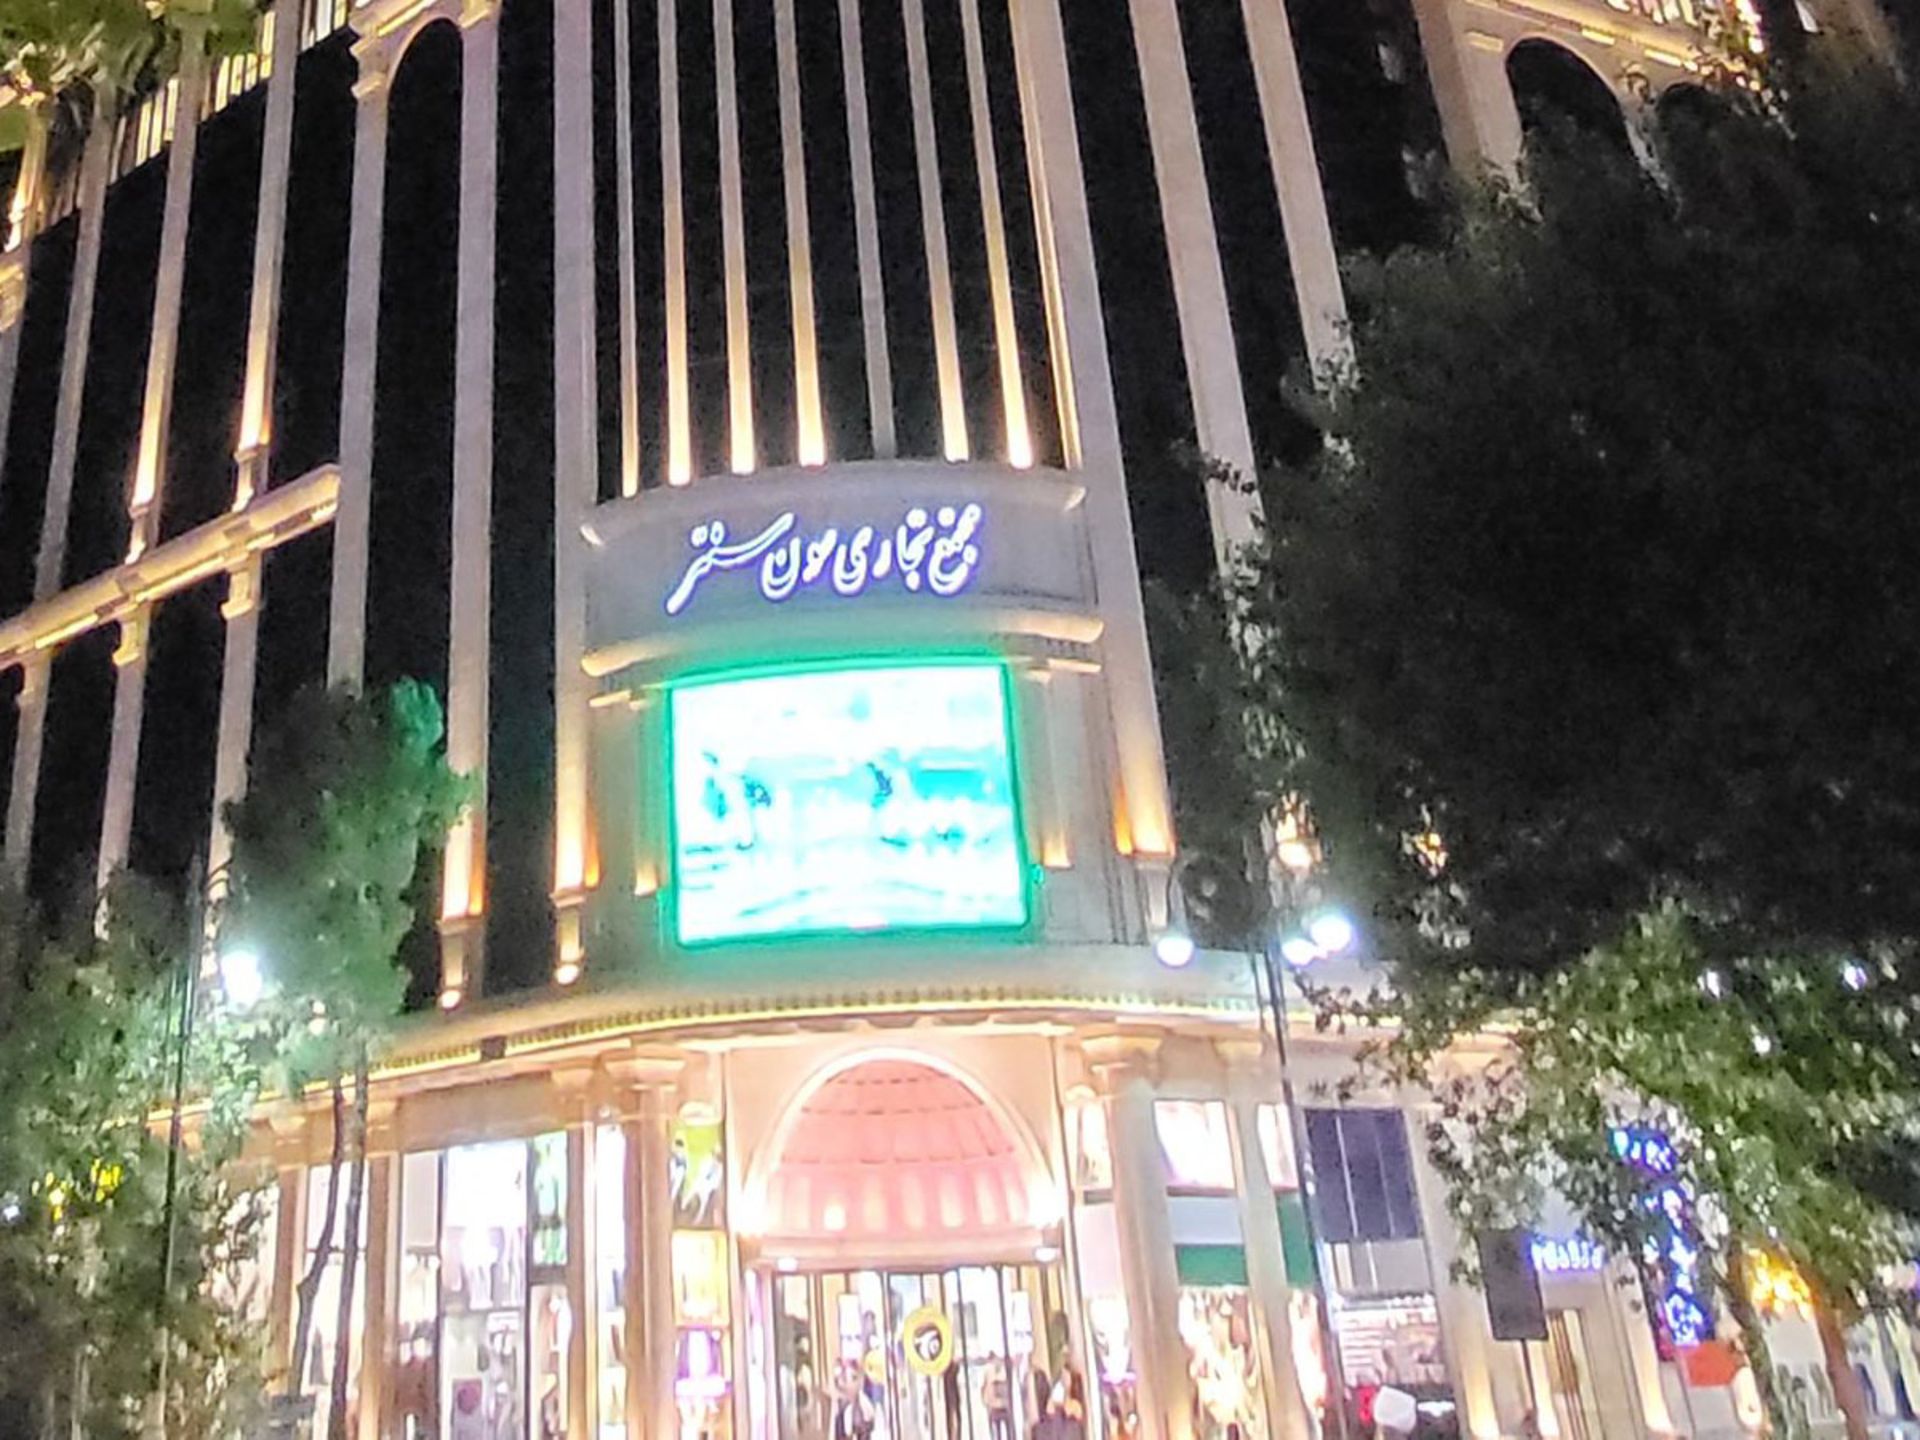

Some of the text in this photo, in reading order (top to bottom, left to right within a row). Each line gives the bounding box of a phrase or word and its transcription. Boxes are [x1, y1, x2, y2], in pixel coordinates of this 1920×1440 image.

[666, 512, 796, 615] سنتر
[833, 508, 935, 595] تجاری
[928, 503, 982, 595] مجتمع
